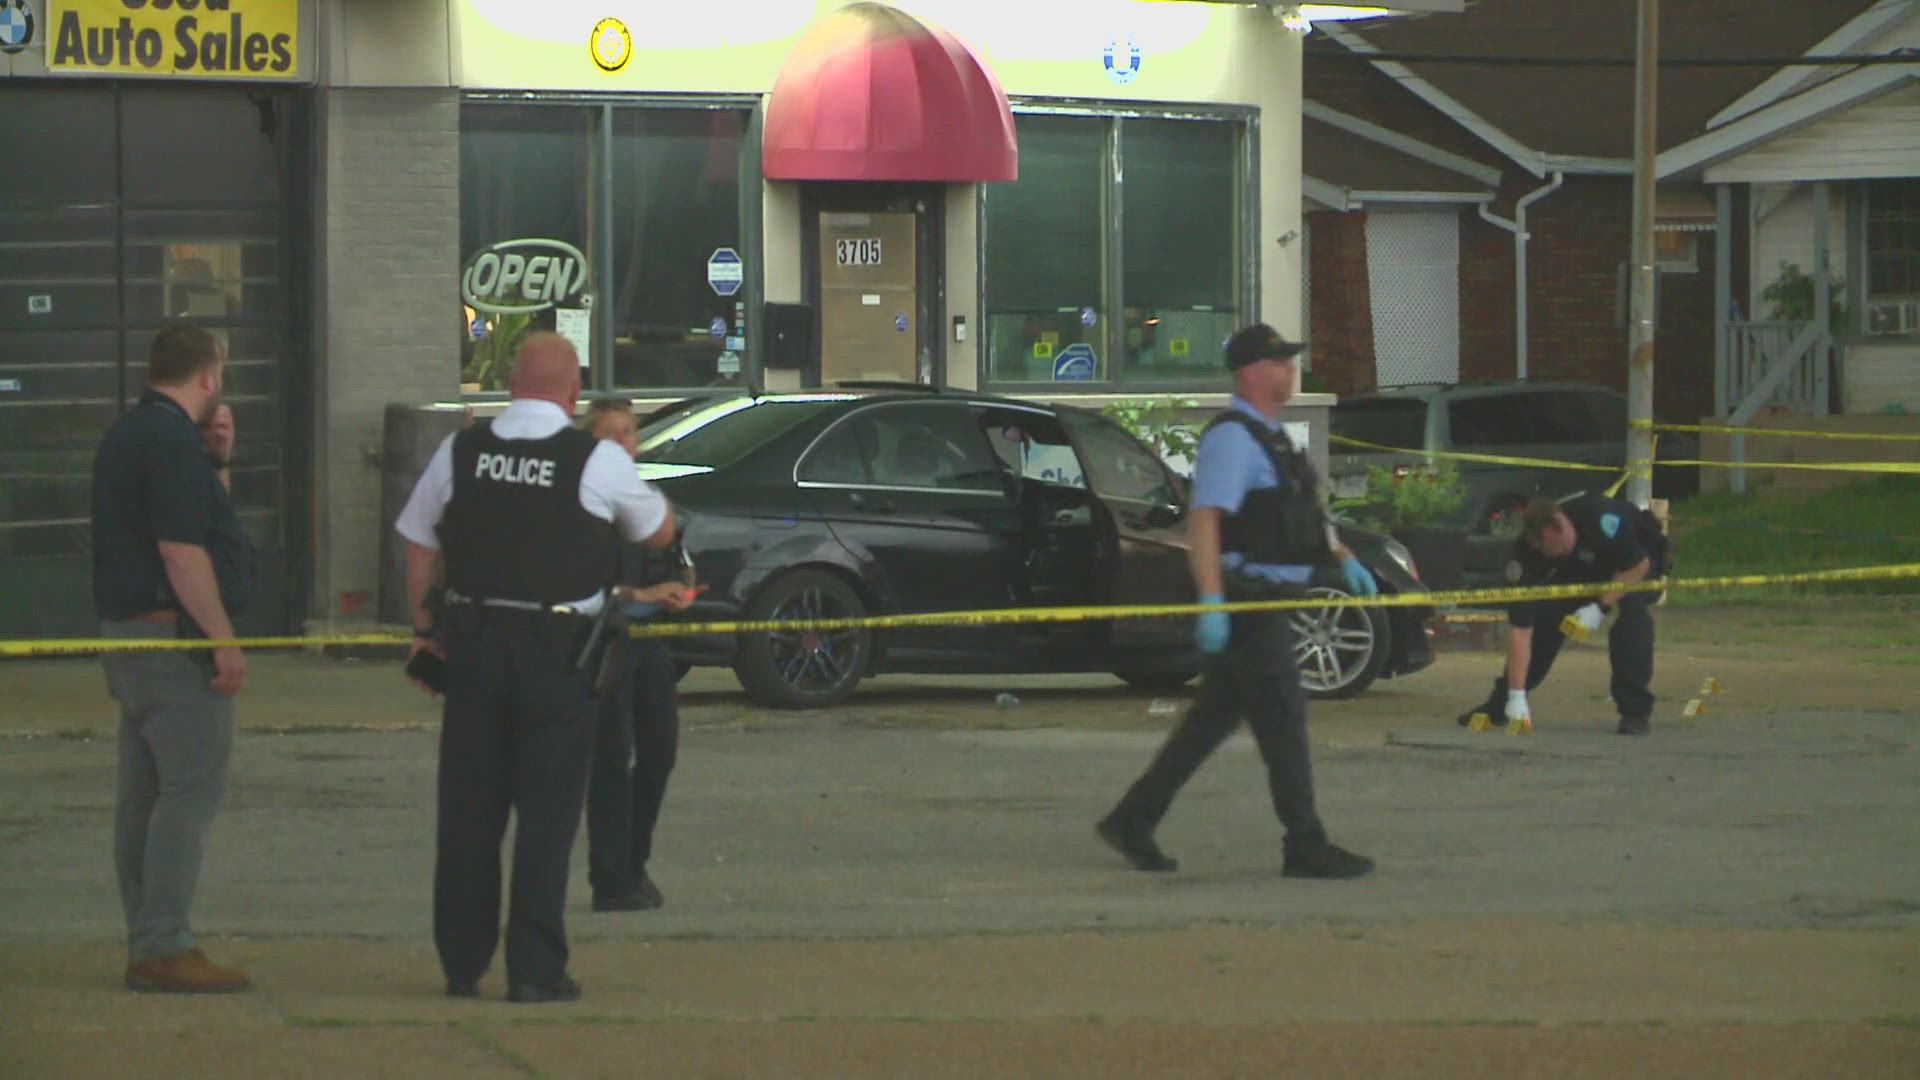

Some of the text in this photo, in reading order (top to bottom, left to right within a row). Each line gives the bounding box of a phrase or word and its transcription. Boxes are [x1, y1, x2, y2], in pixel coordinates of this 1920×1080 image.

[53, 10, 292, 72] Auto Sales
[838, 240, 879, 263] 3705
[471, 252, 575, 301] OPEN
[475, 452, 556, 487] POLICE
